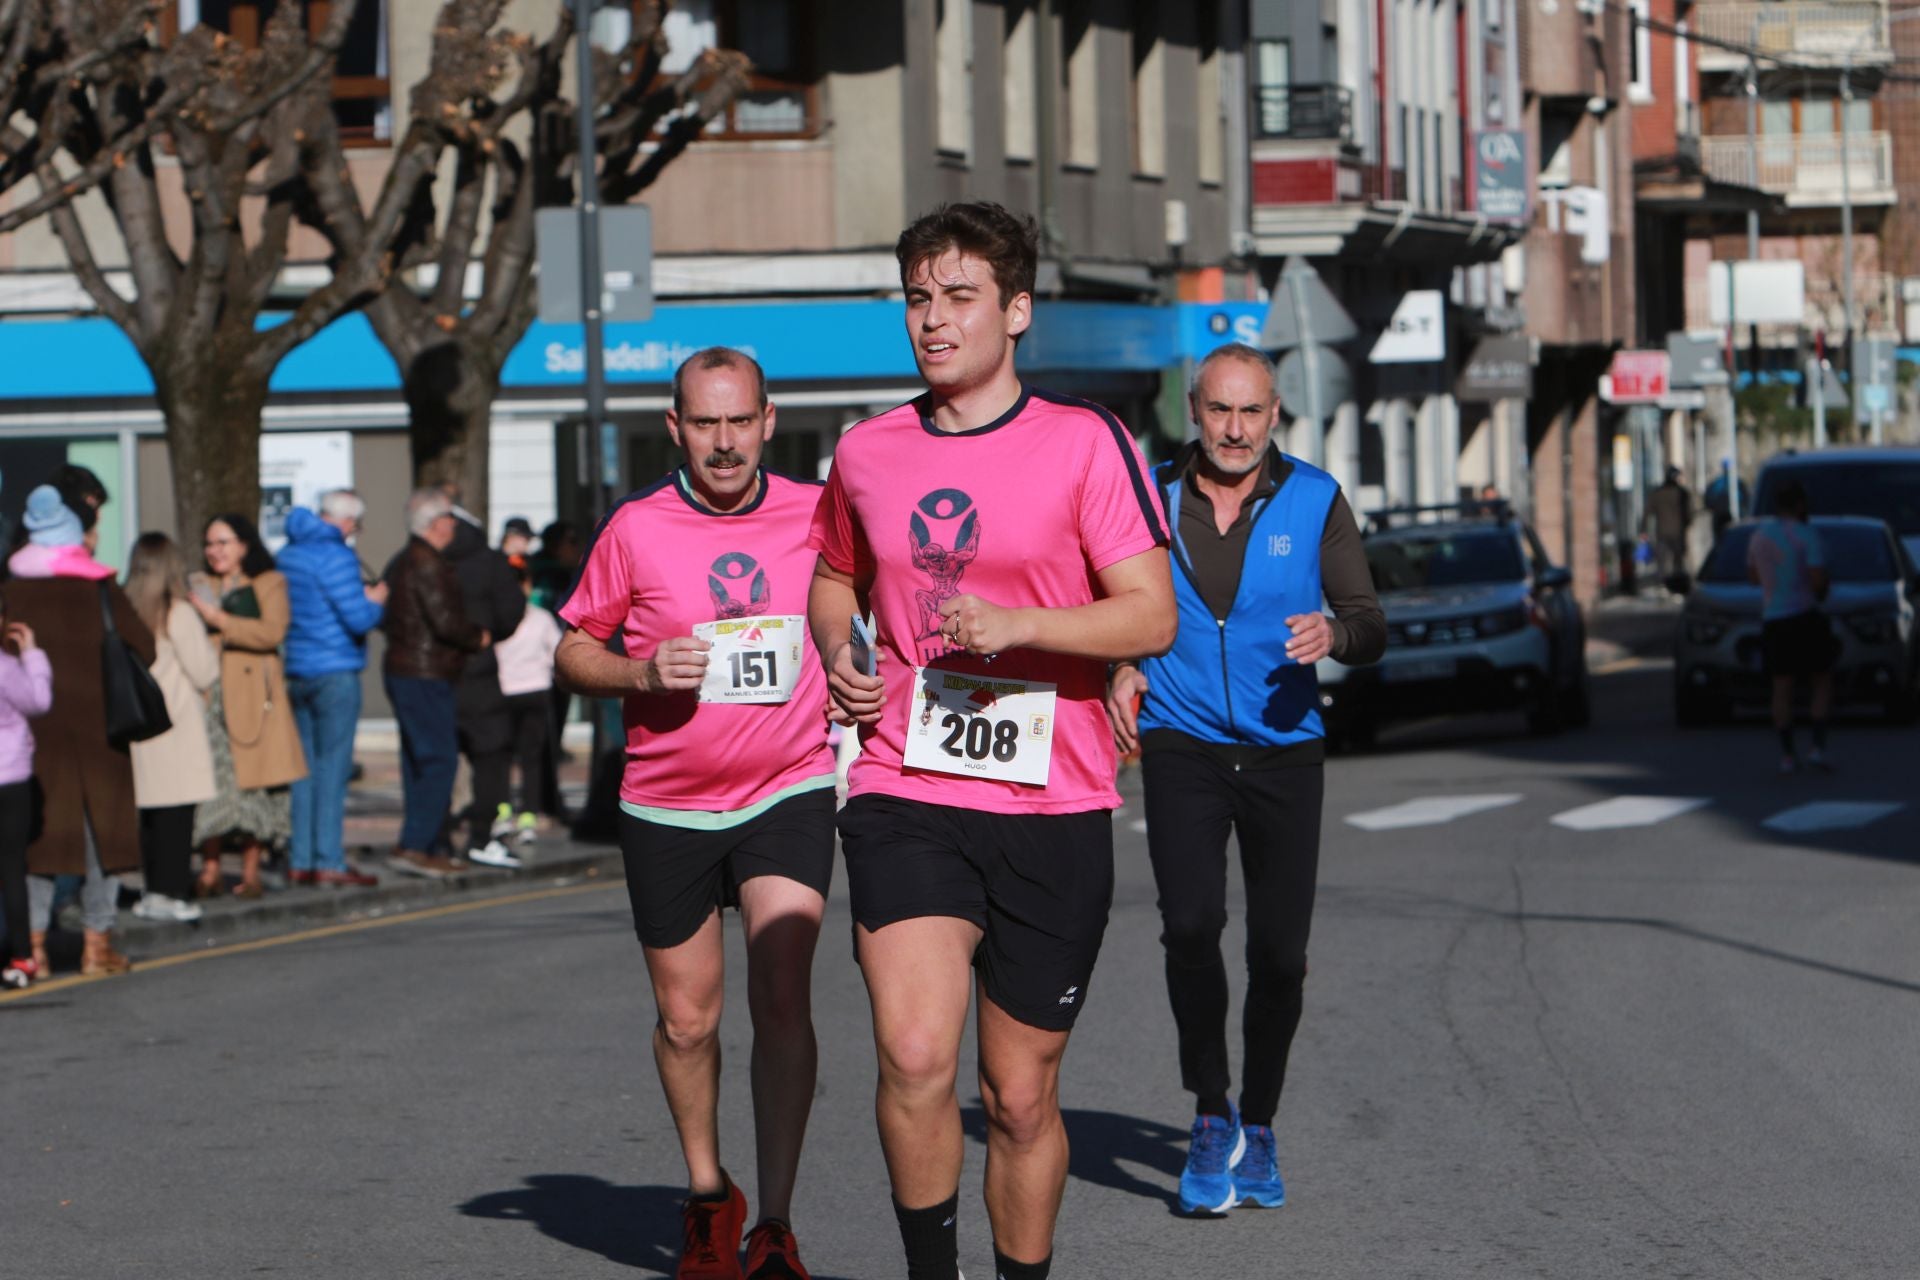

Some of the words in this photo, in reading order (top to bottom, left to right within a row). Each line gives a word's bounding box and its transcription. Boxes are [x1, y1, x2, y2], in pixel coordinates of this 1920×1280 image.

[727, 651, 778, 688] 151
[938, 713, 1019, 763] 208
[964, 762, 987, 771] HUGO
